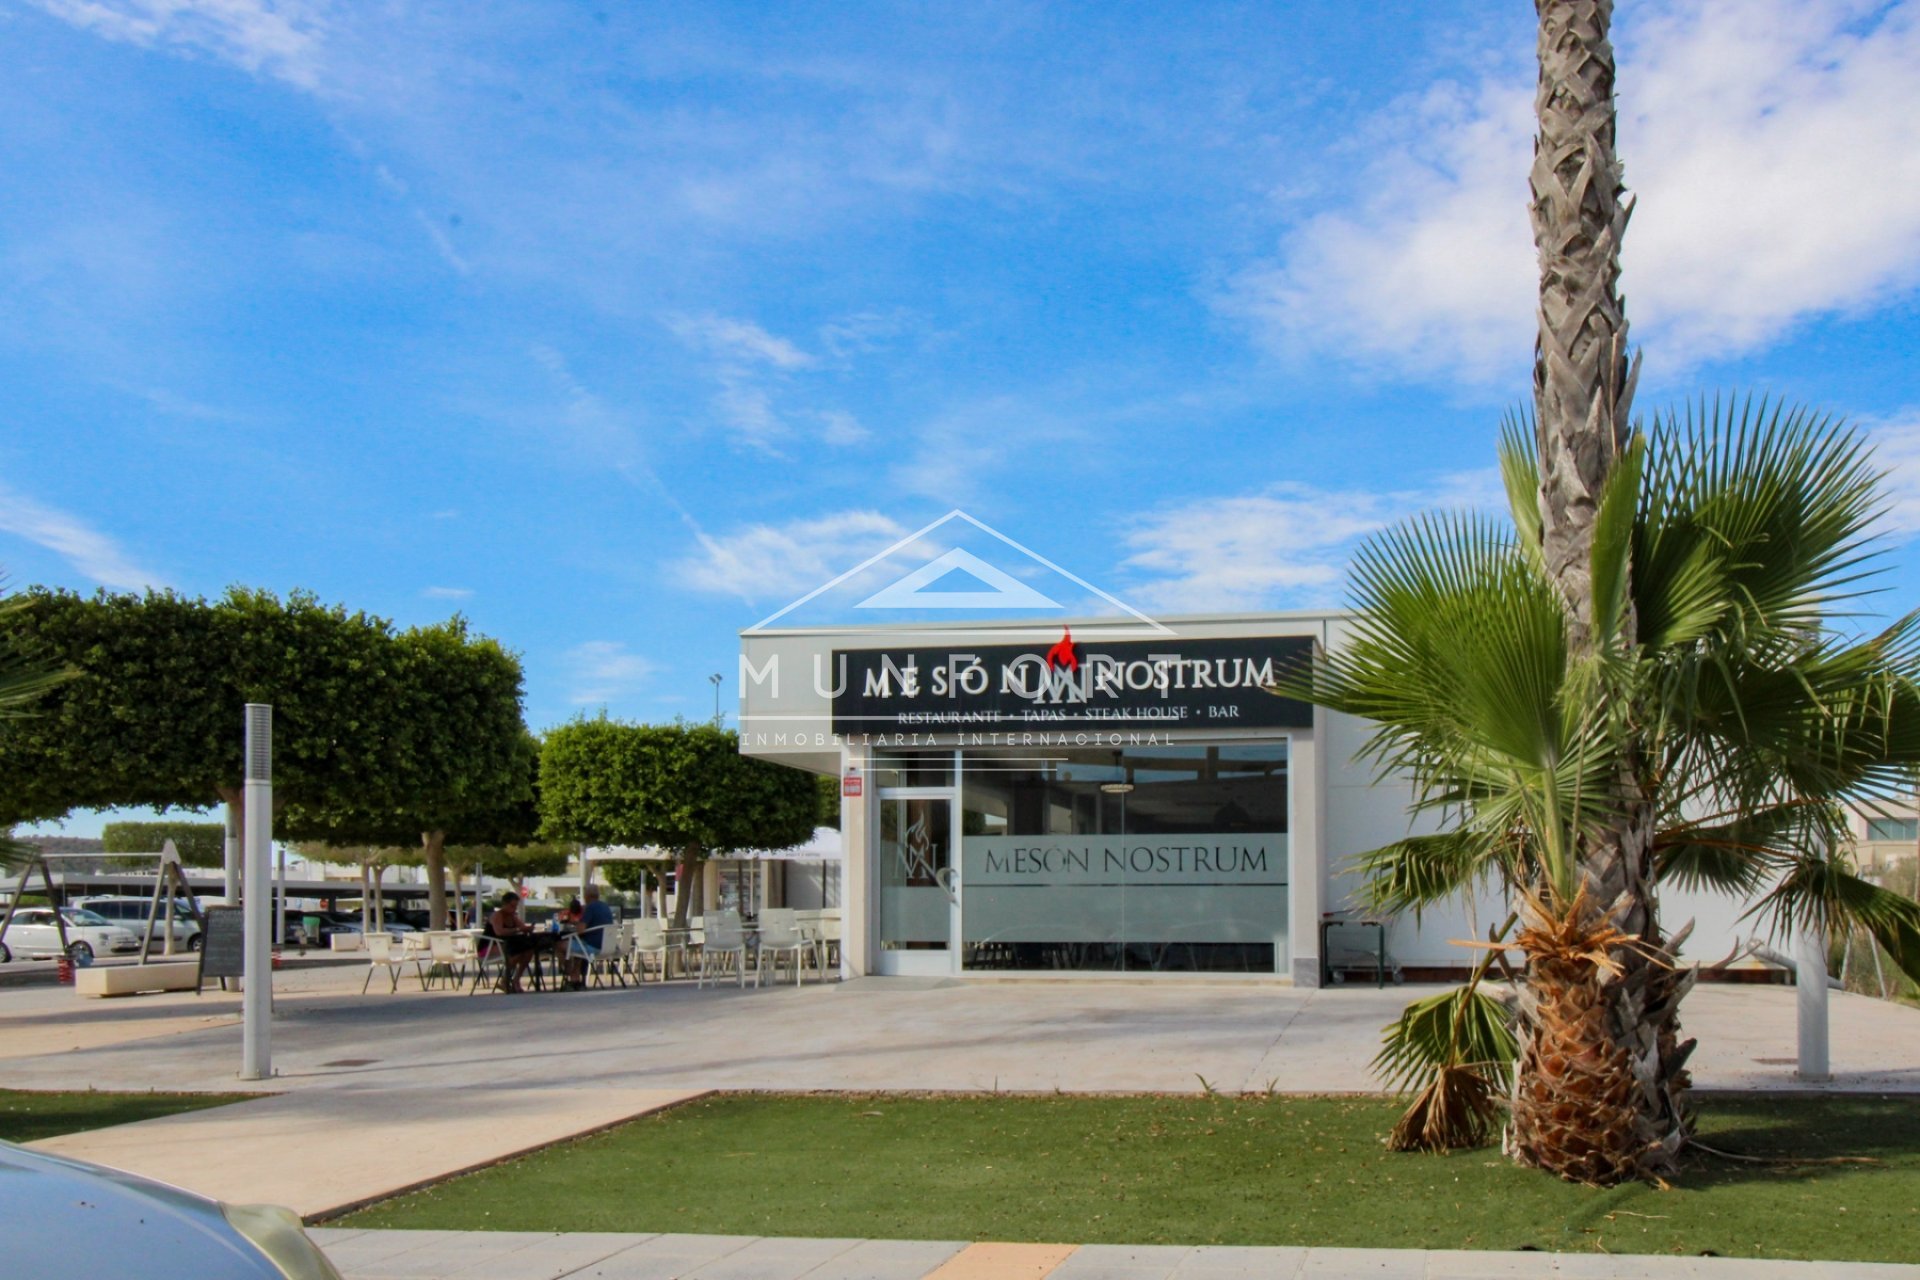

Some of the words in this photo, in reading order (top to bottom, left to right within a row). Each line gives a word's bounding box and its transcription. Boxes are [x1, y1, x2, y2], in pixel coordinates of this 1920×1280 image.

[862, 656, 1030, 698] MESÓN
[1094, 656, 1278, 692] NOSTRUM
[898, 710, 1002, 725] RESTAURANTE
[1021, 708, 1067, 722] TAPAS
[1085, 706, 1132, 721] STEAK
[1136, 705, 1188, 720] HOUSE
[1208, 704, 1240, 719] BAR
[1103, 846, 1268, 873] NOSTRUM
